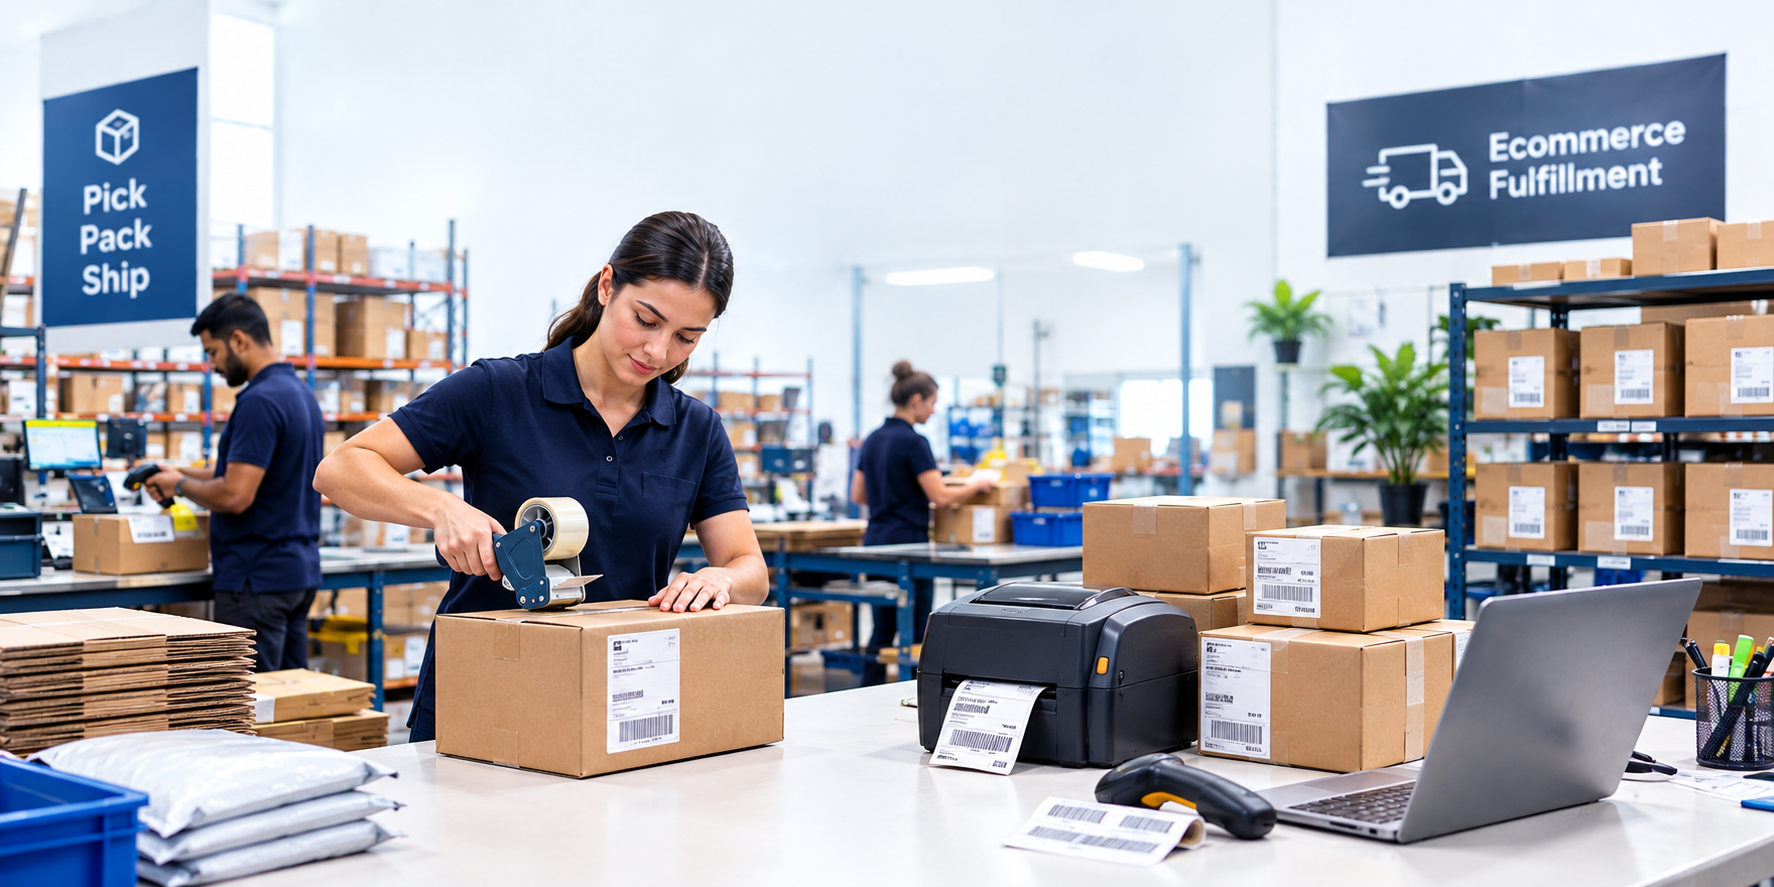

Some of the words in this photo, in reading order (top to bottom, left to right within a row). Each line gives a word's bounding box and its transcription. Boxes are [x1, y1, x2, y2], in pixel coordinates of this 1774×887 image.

[1489, 120, 1686, 163] Ecommerce
[83, 178, 147, 214] Pick
[1489, 157, 1663, 200] Fulfillment
[80, 218, 152, 254] Pack
[82, 261, 150, 298] Ship
